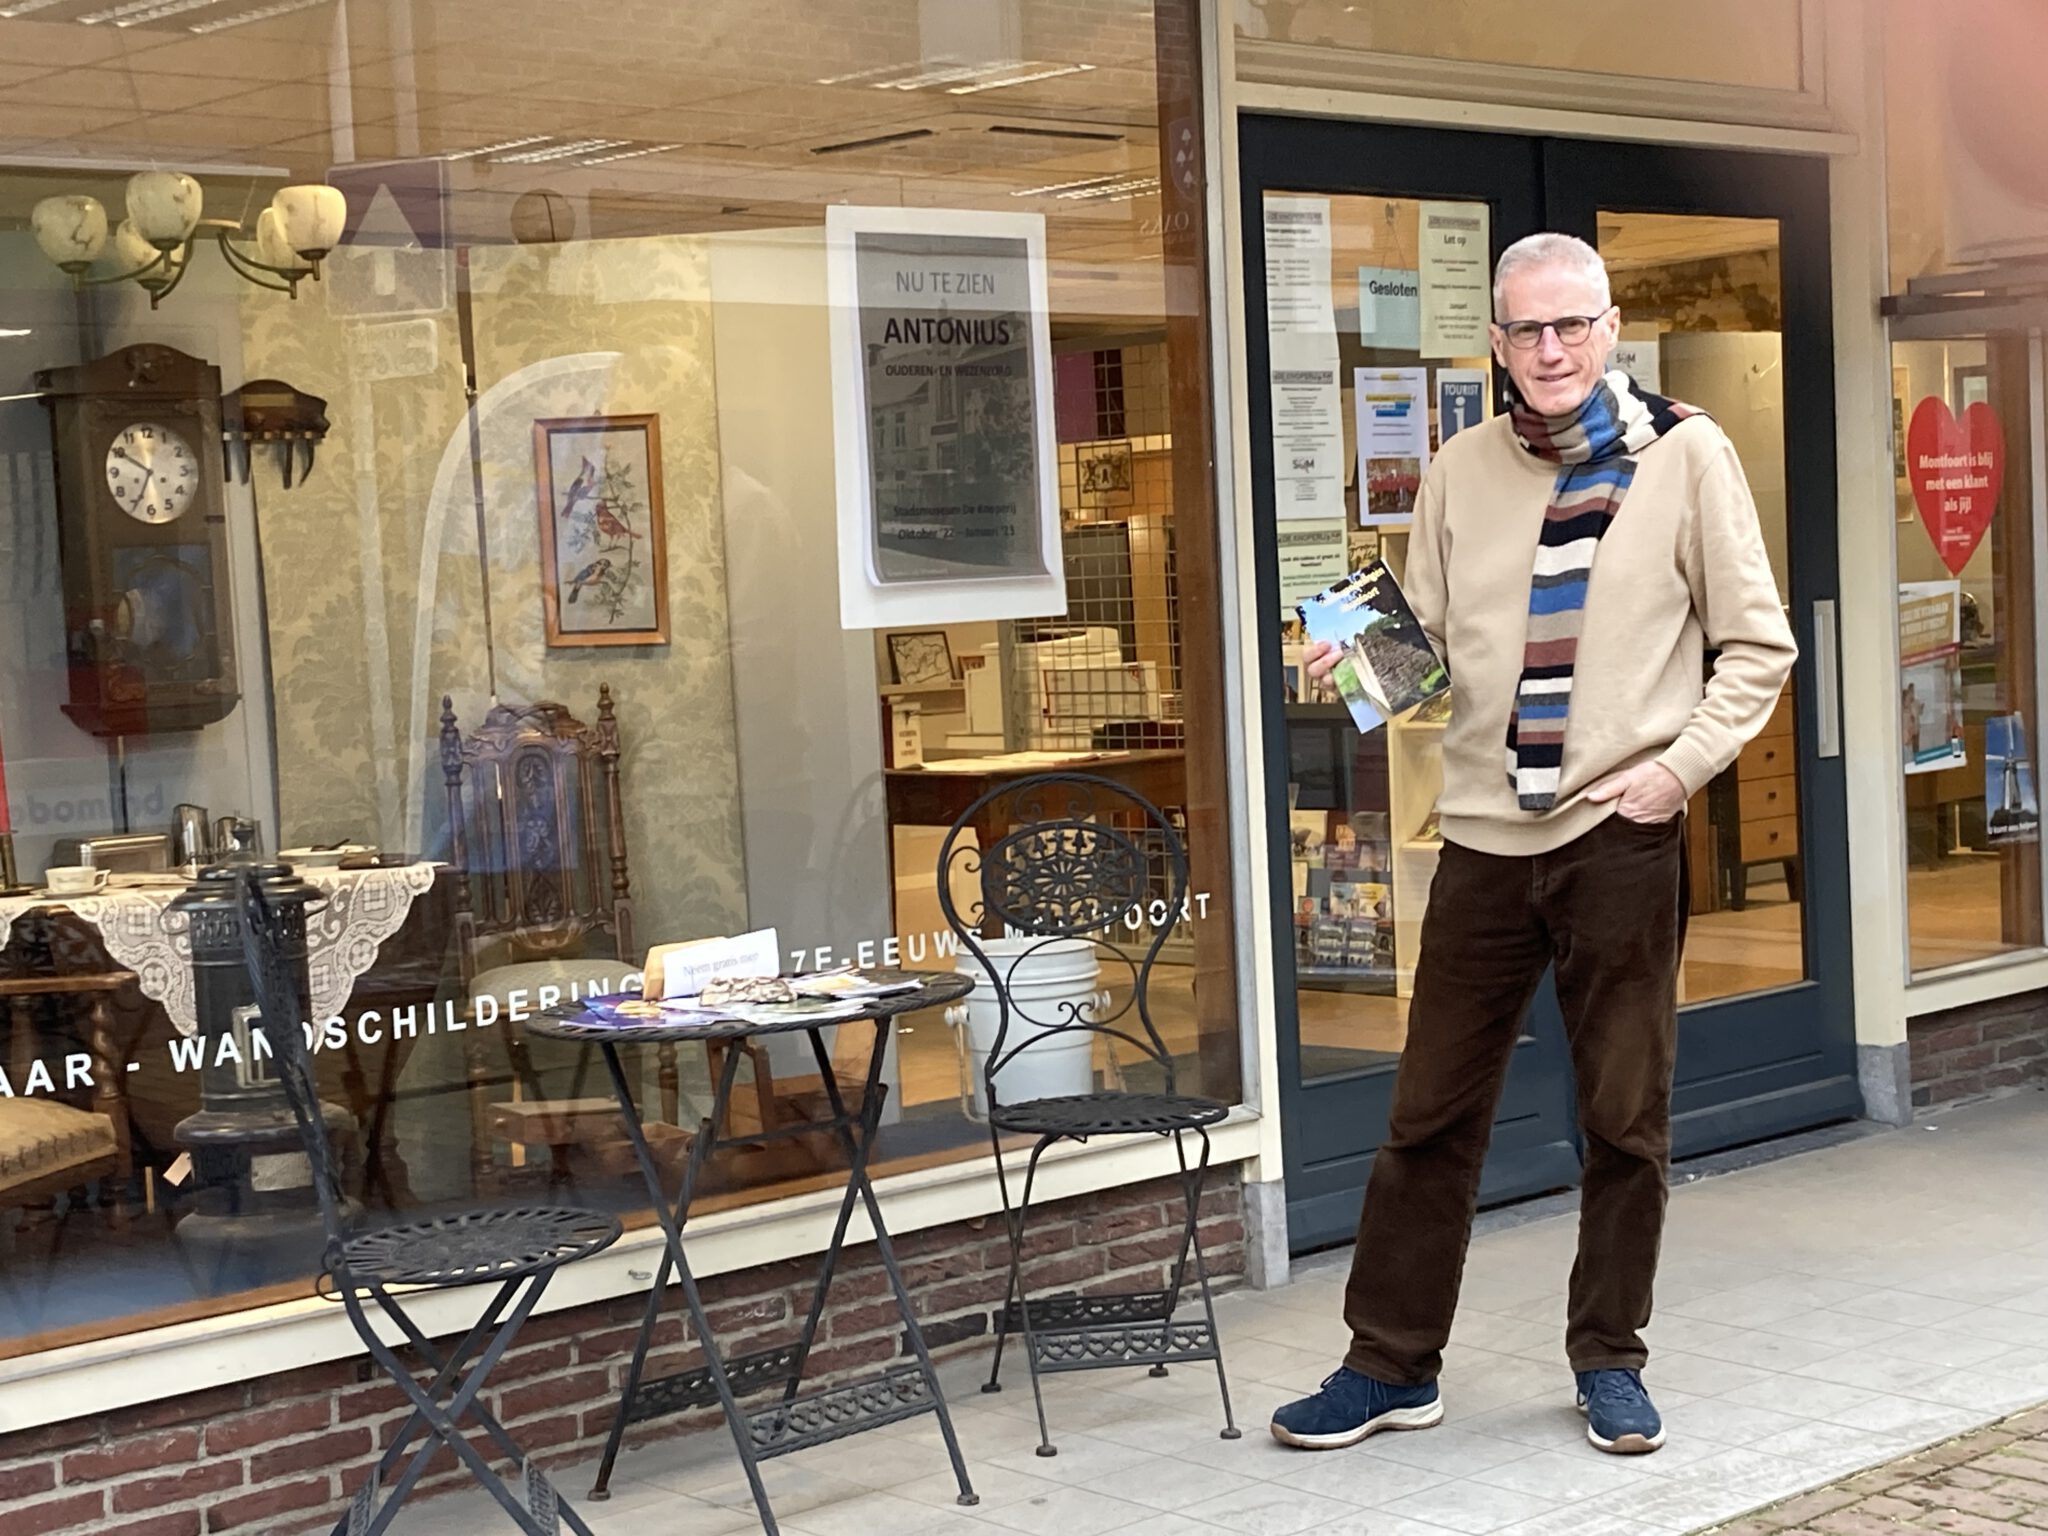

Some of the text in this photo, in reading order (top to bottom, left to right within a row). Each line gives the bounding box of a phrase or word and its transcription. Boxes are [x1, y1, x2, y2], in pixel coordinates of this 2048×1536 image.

[896, 271, 995, 295] NU TE ZIEN
[1369, 280, 1418, 297] Gesloten
[884, 317, 1010, 345] ANTONIUS
[1444, 383, 1480, 396] TOURIST
[123, 432, 135, 444] 11
[141, 427, 154, 440] 12
[162, 431, 167, 444] 1
[174, 446, 182, 458] 2
[1919, 451, 1994, 470] Montfoort is blij
[109, 467, 119, 479] 9
[180, 466, 189, 477] 3
[1925, 474, 1989, 491] met een klant
[116, 486, 125, 498] 8
[175, 485, 184, 495] 4
[146, 504, 156, 516] 6
[164, 498, 173, 511] 5
[1944, 497, 1958, 512] als
[897, 528, 937, 541] Oktober
